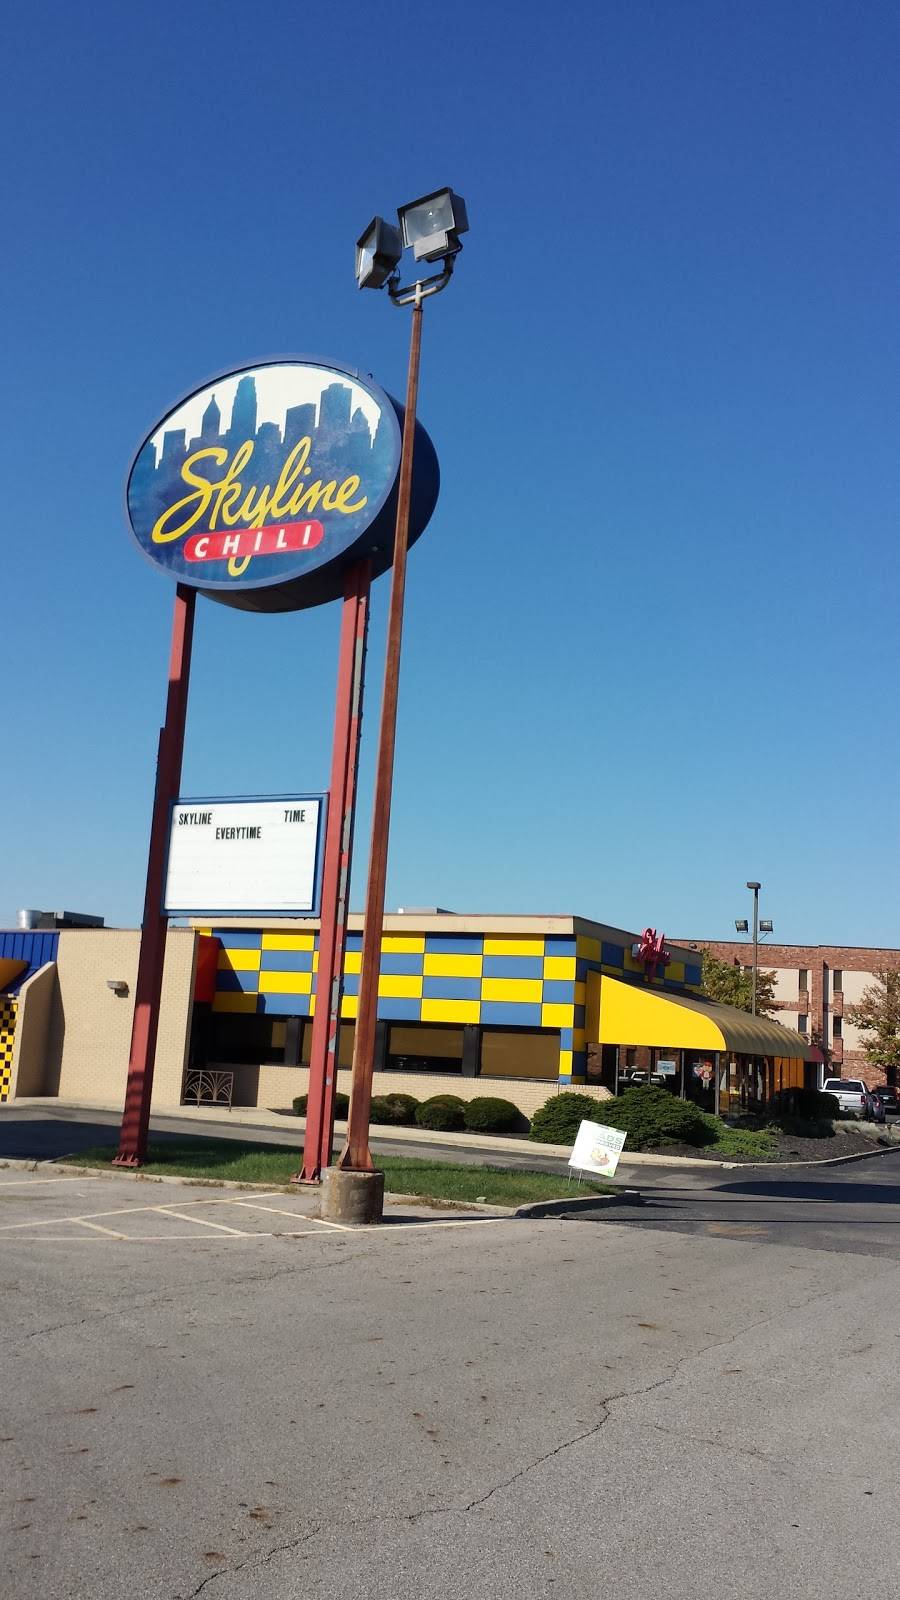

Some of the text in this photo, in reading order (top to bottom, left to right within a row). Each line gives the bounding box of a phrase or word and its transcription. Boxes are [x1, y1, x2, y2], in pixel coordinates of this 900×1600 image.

[152, 437, 367, 576] Skyline
[194, 525, 311, 558] CHILI
[179, 810, 305, 825] SKYLINE TIME
[215, 827, 262, 840] EVERYTIME
